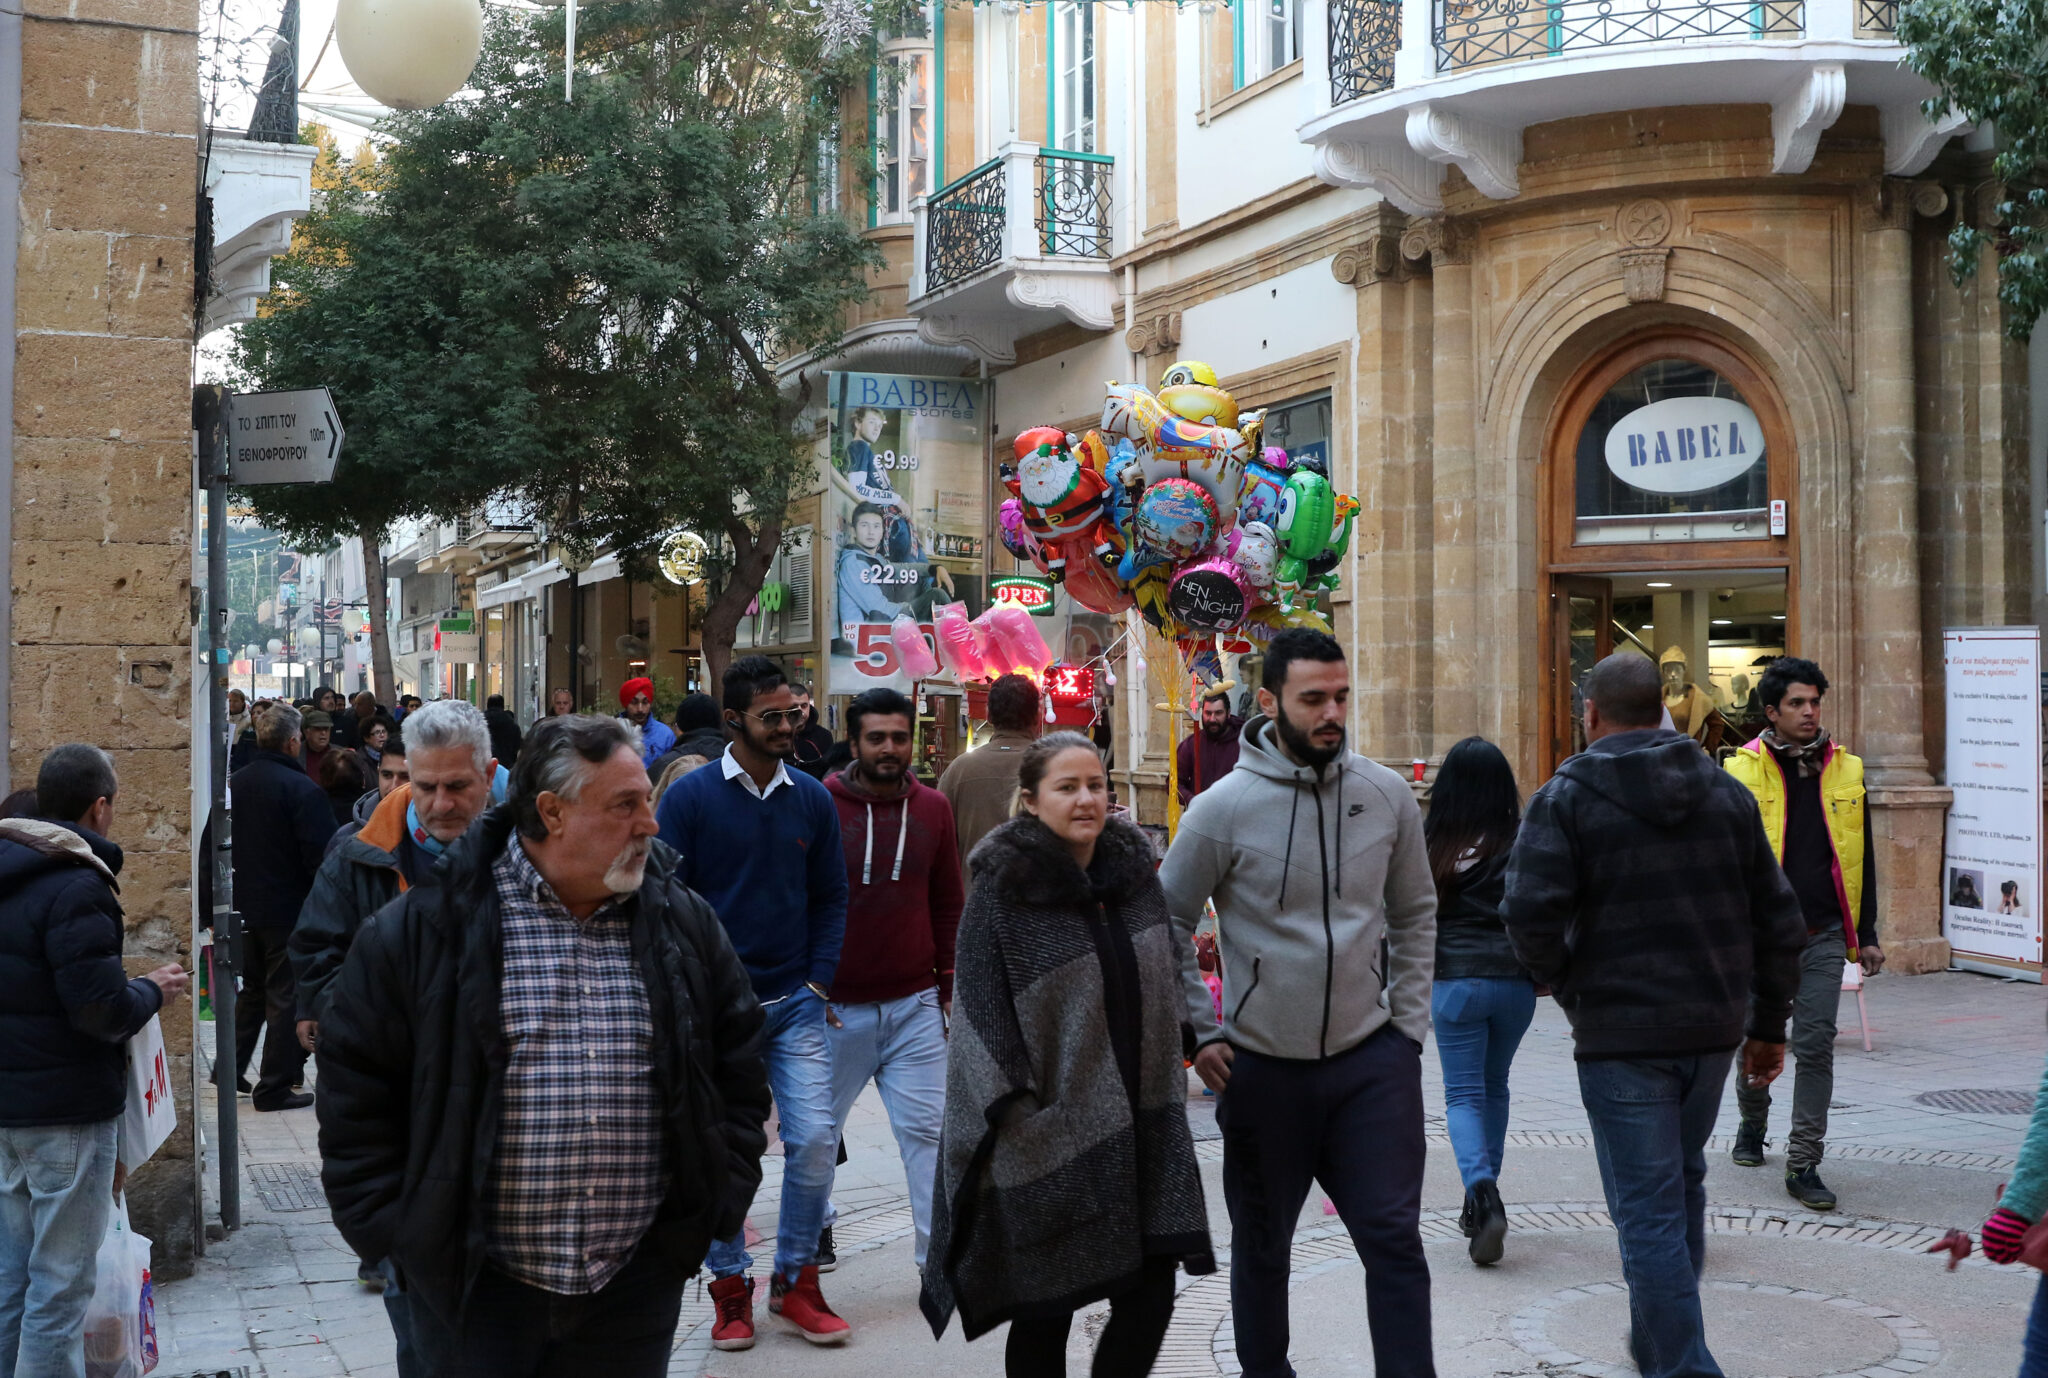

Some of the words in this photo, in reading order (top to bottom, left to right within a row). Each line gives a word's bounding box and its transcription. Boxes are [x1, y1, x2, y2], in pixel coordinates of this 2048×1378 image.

[238, 417, 251, 431] ΤΟ
[255, 415, 278, 430] ΣΠΙΤΙ
[280, 413, 297, 428] ΤΟΥ
[907, 407, 974, 420] stores
[309, 428, 326, 442] 100m
[238, 446, 308, 462] ΕΘΝΟΦΡΟΥΡΟΥ
[873, 450, 919, 470] €9.99
[860, 565, 918, 584] €22.99
[997, 587, 1046, 604] OPEN
[1180, 578, 1210, 599] HEN
[1193, 597, 1242, 615] NIGHT
